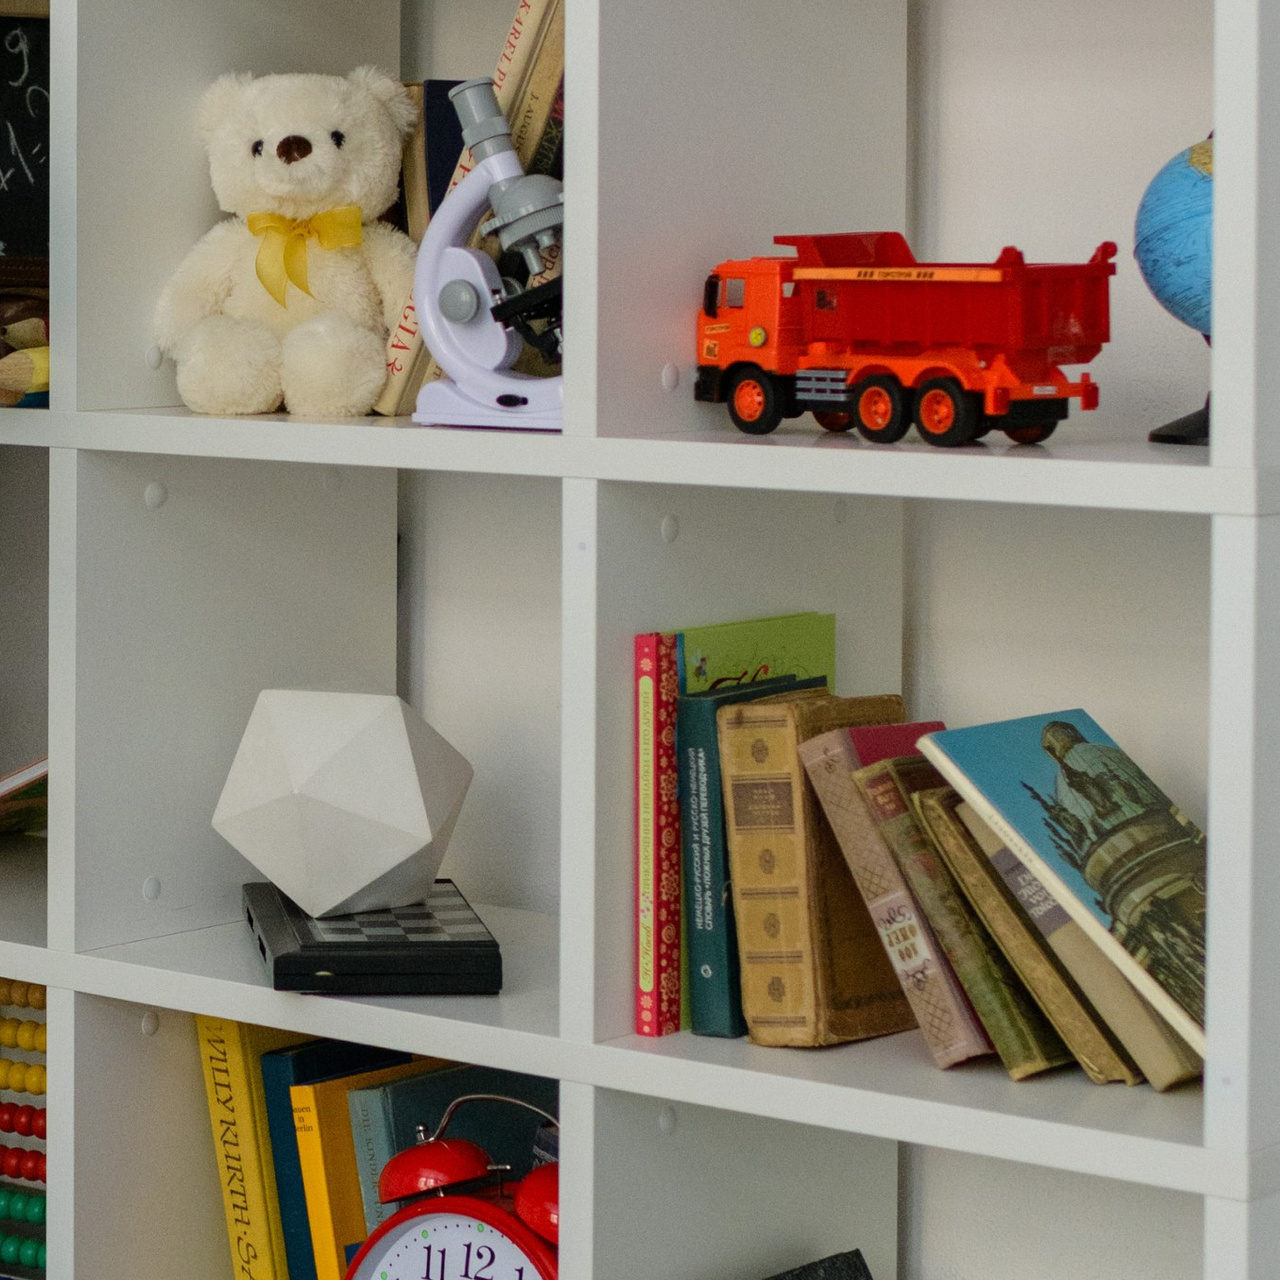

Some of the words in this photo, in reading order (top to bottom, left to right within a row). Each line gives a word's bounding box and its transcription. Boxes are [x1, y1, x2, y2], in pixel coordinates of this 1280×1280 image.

[202, 1026, 235, 1122] WILLY
[292, 1106, 311, 1114] auen
[295, 1124, 314, 1133] erlin
